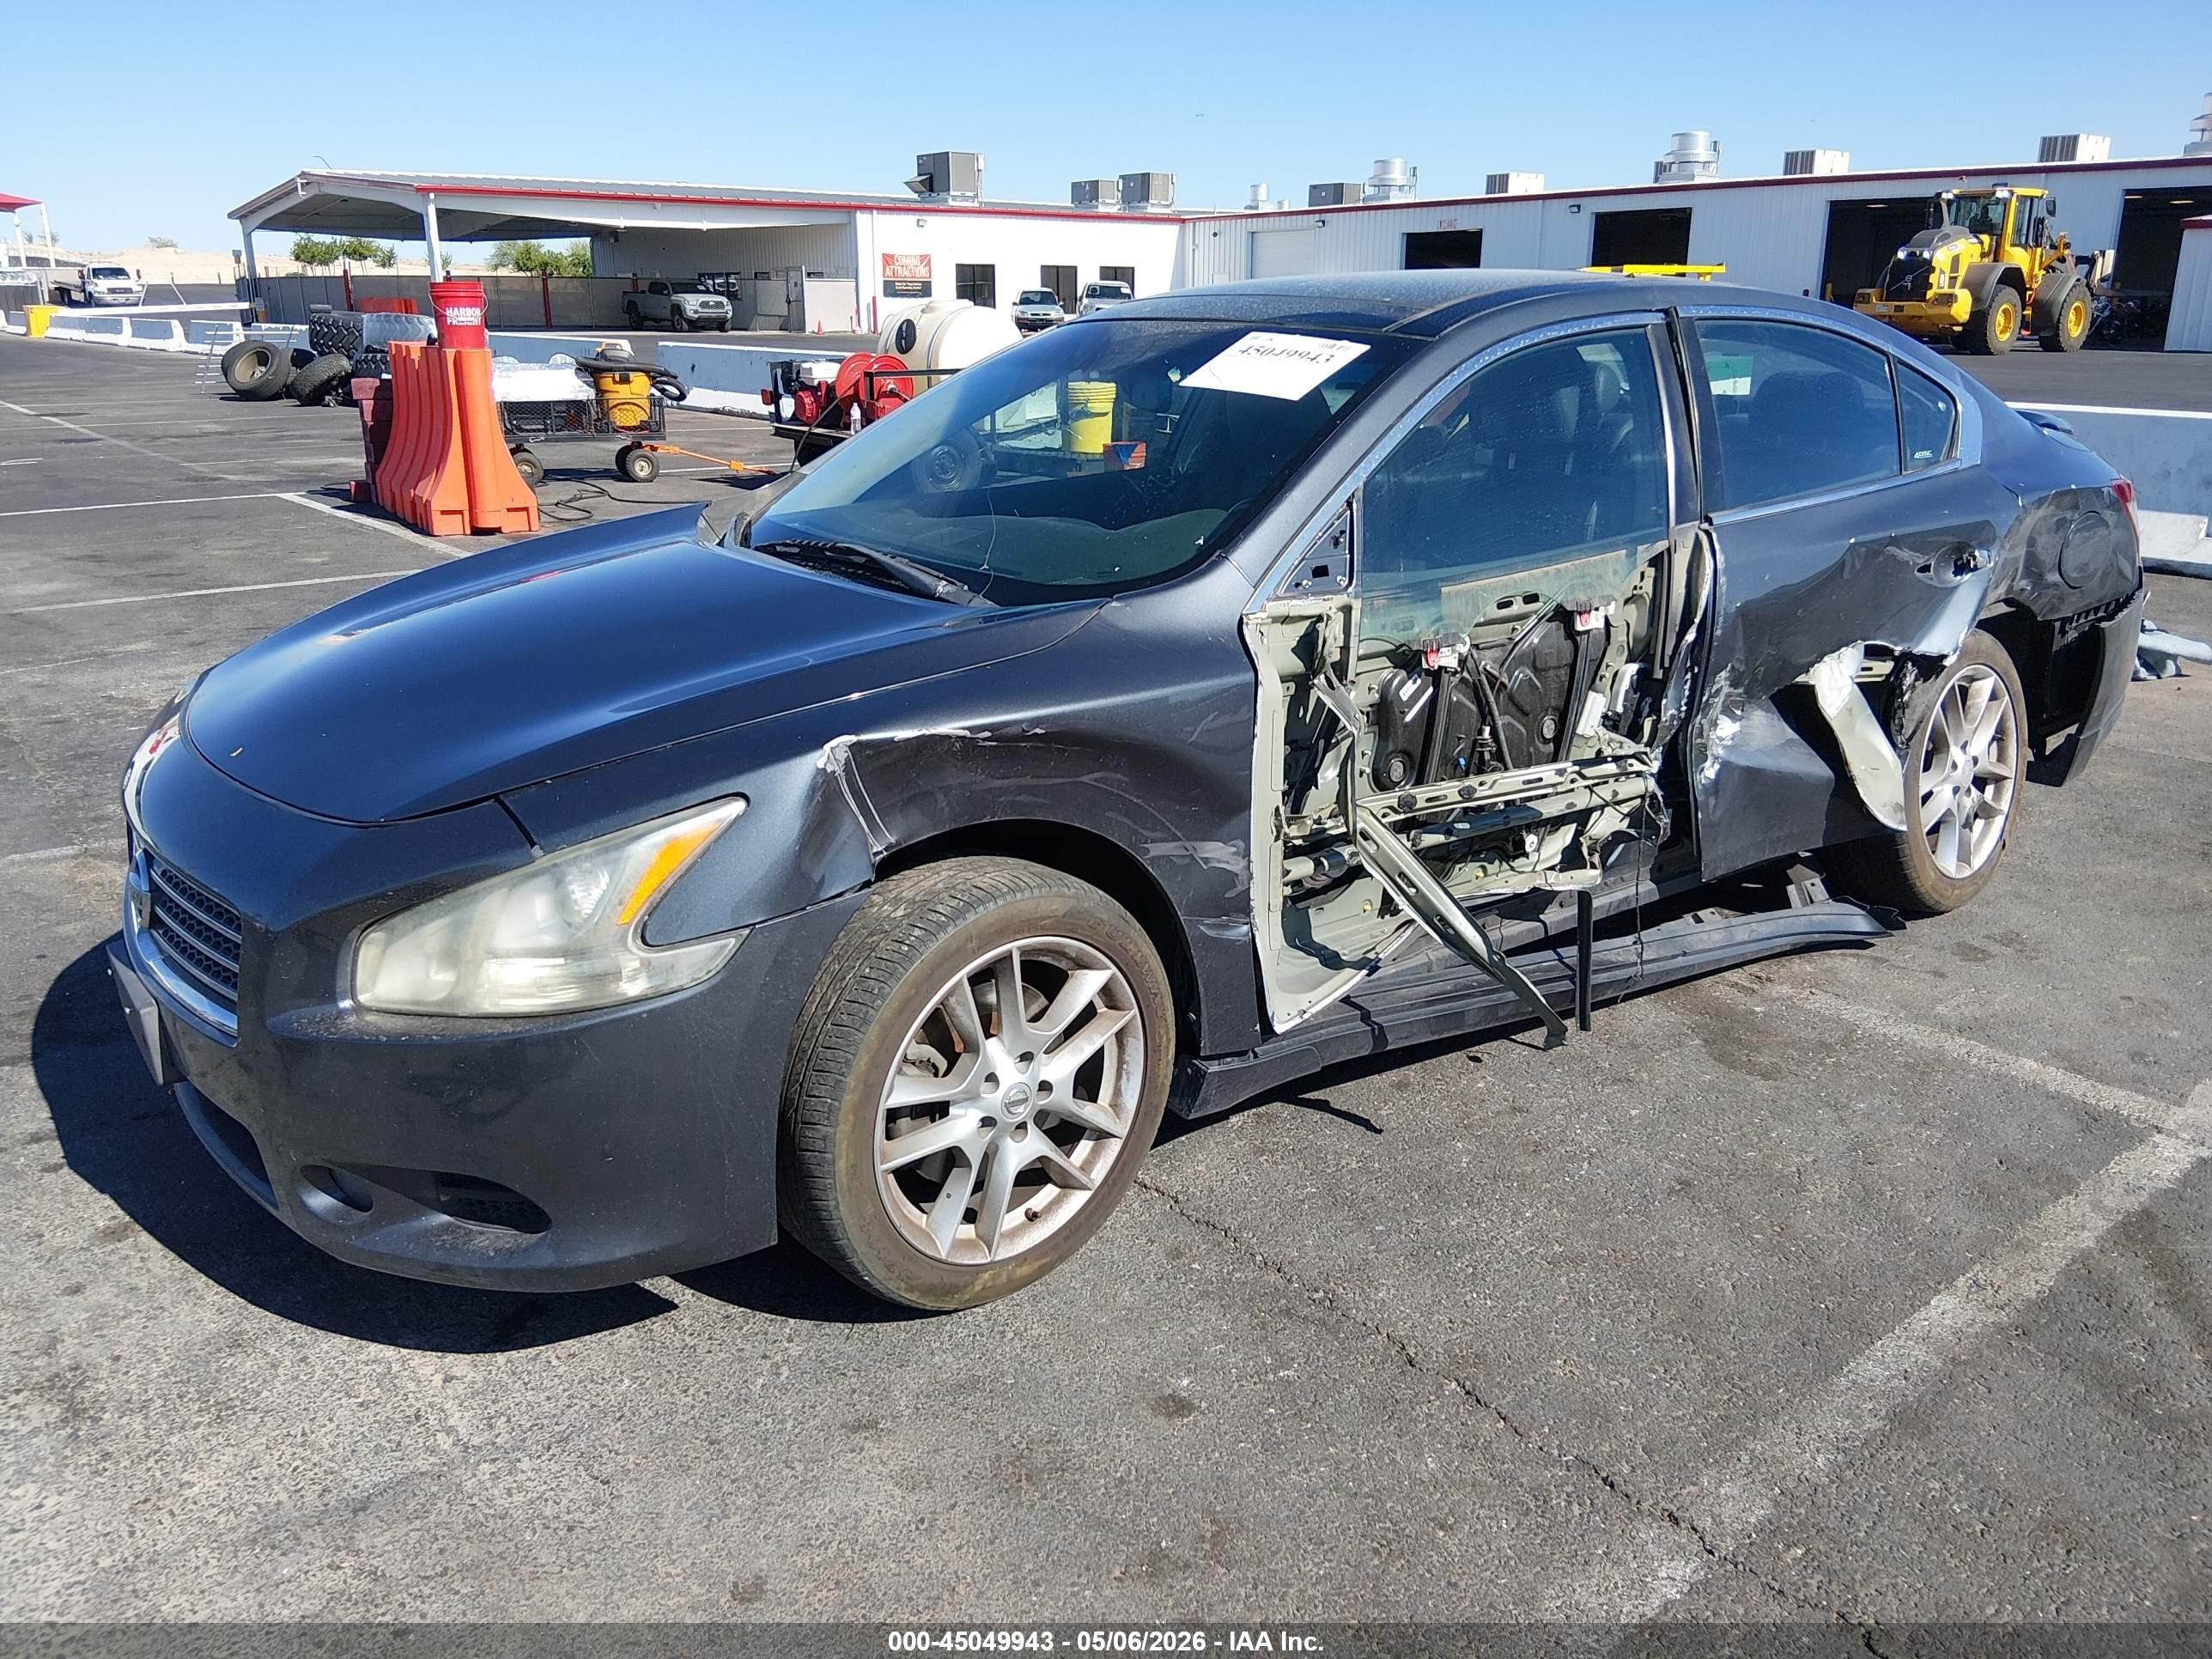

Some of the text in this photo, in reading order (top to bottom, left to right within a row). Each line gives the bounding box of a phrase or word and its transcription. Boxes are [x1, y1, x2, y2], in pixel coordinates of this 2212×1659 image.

[894, 255, 921, 266] COMING
[885, 265, 930, 277] ATTRACTIONS
[446, 307, 482, 317] HARBOR
[447, 316, 482, 325] FREIGHT
